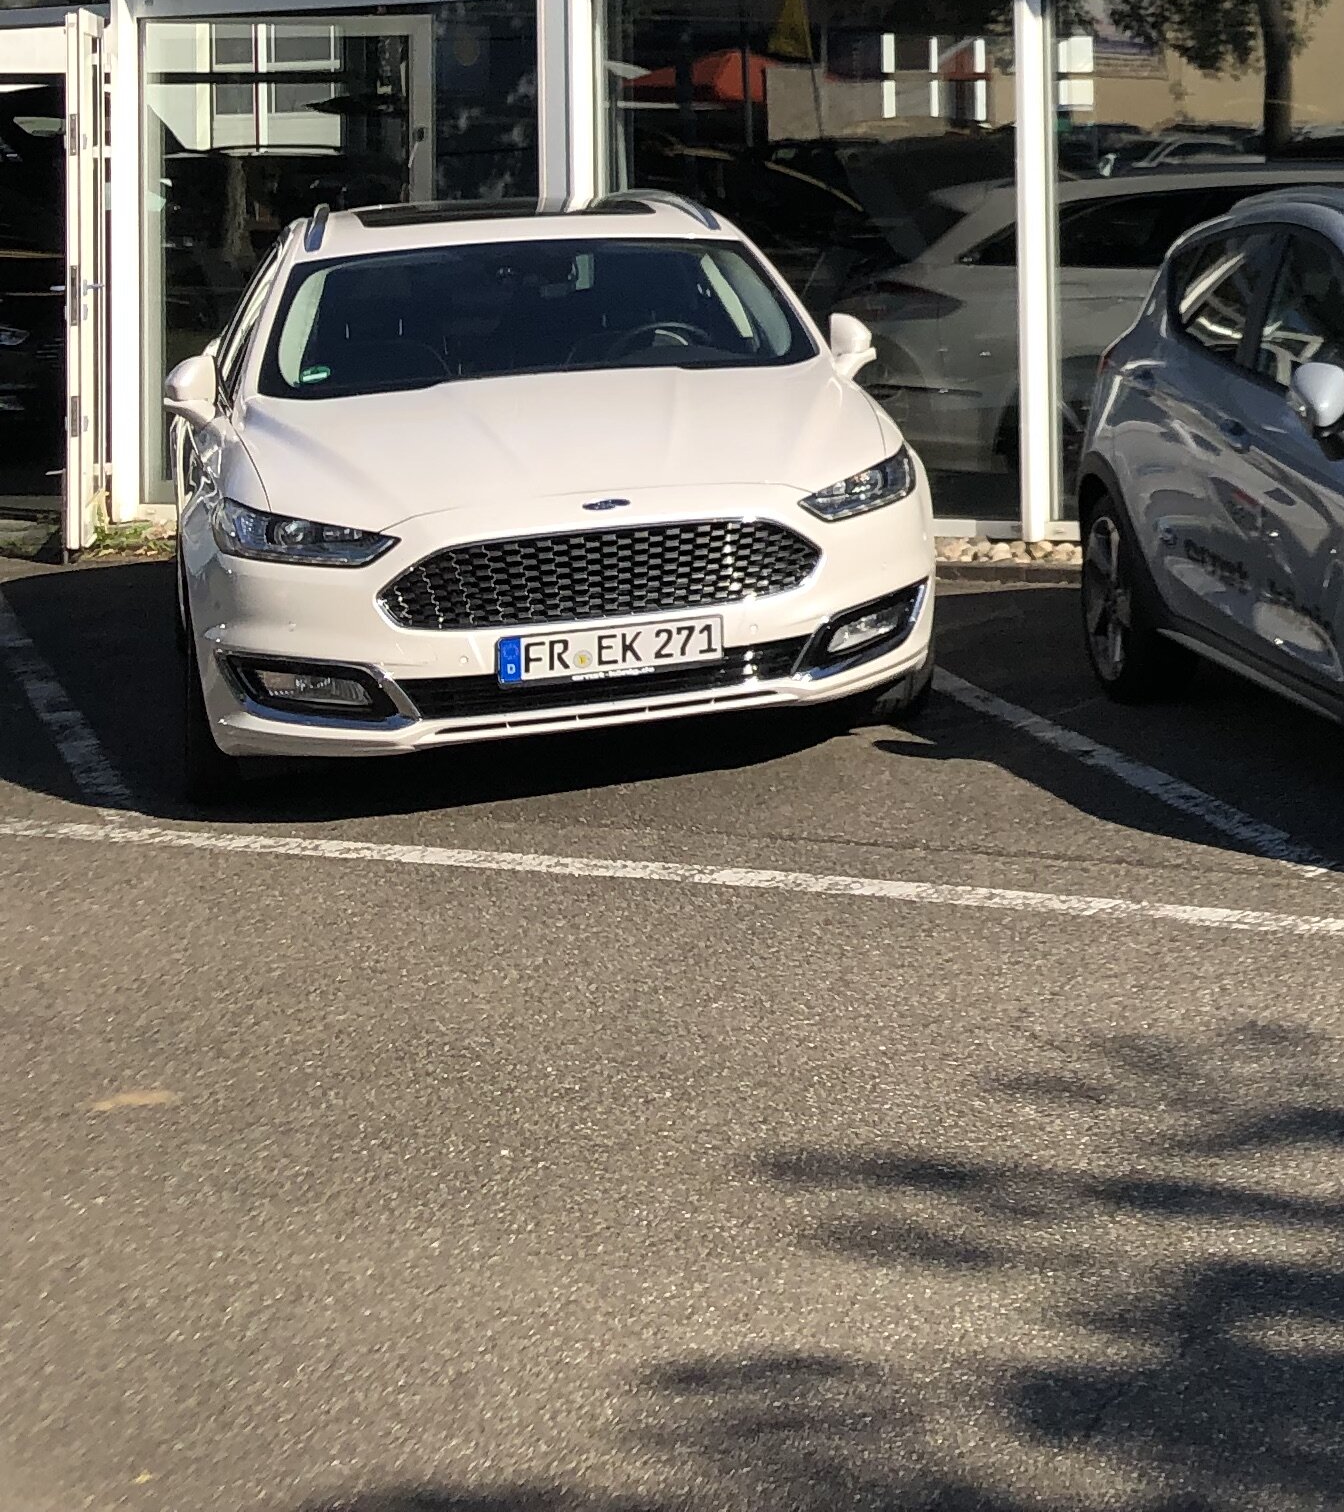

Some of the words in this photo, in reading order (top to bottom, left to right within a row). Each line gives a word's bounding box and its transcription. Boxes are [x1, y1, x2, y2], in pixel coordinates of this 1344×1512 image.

[506, 663, 516, 675] D
[523, 639, 571, 673] FR
[597, 631, 642, 666] EK
[653, 623, 718, 660] 271
